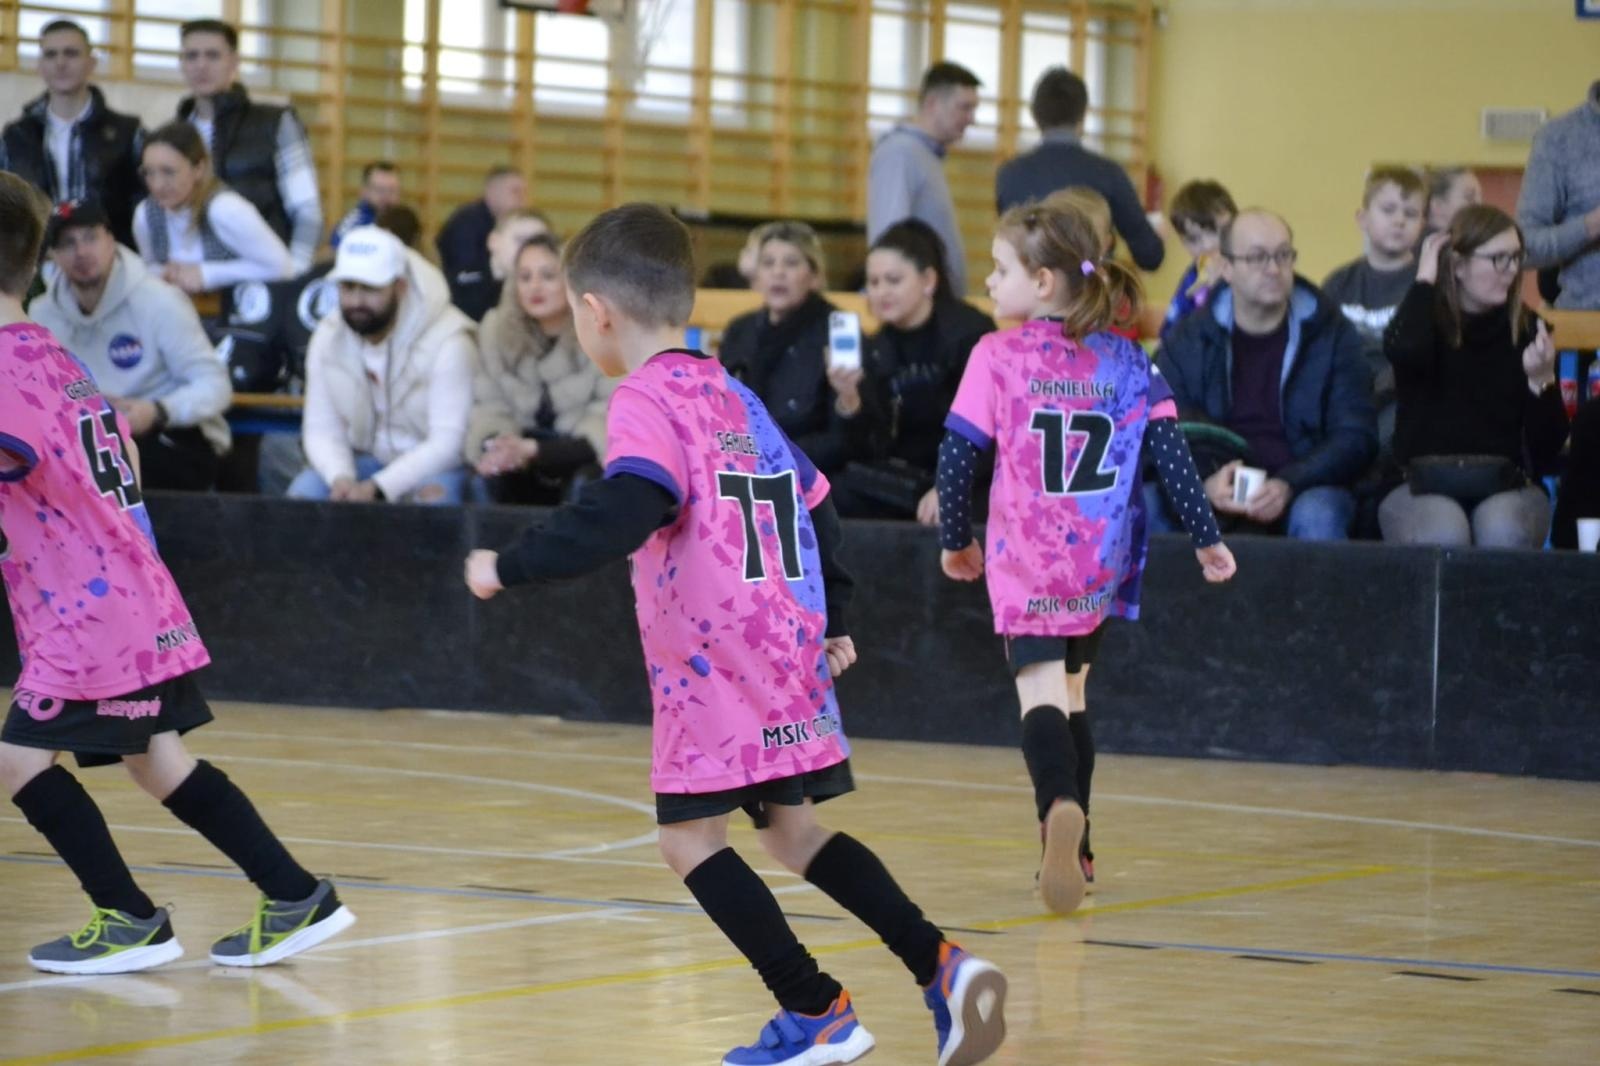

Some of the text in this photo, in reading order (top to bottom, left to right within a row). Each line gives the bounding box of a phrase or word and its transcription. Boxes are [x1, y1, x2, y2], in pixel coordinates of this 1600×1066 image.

[1027, 408, 1121, 496] 12
[1026, 597, 1061, 614] MSK
[761, 720, 810, 750] MSK
